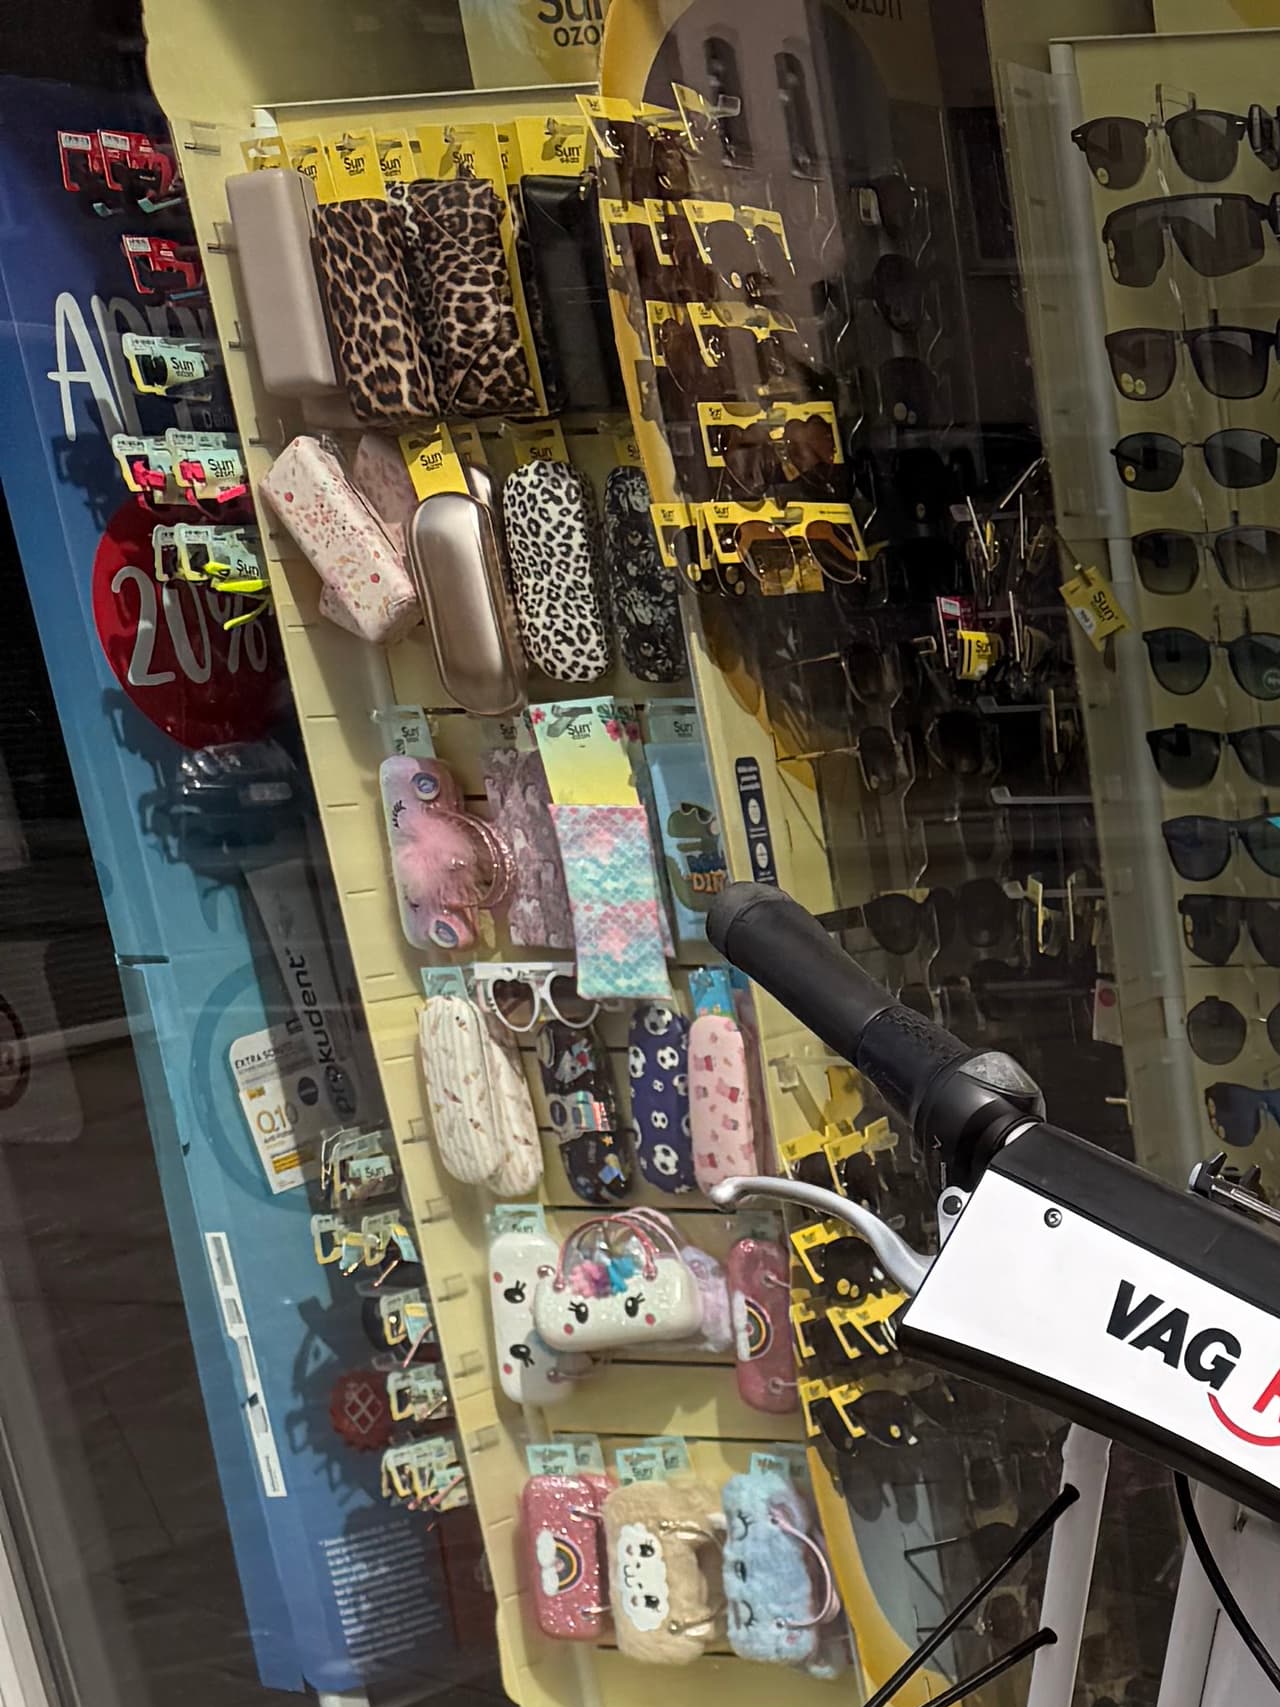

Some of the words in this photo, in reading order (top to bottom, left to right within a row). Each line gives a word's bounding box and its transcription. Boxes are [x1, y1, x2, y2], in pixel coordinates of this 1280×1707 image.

[554, 24, 605, 47] ozo
[555, 144, 580, 158] Sun
[344, 157, 365, 170] Sun
[380, 158, 401, 171] Sun
[171, 356, 194, 372] Sun
[207, 459, 234, 472] Sun
[420, 453, 443, 466] Sun
[1093, 591, 1117, 621] Sun
[567, 723, 591, 736] Sun
[1106, 1279, 1242, 1391] VAG
